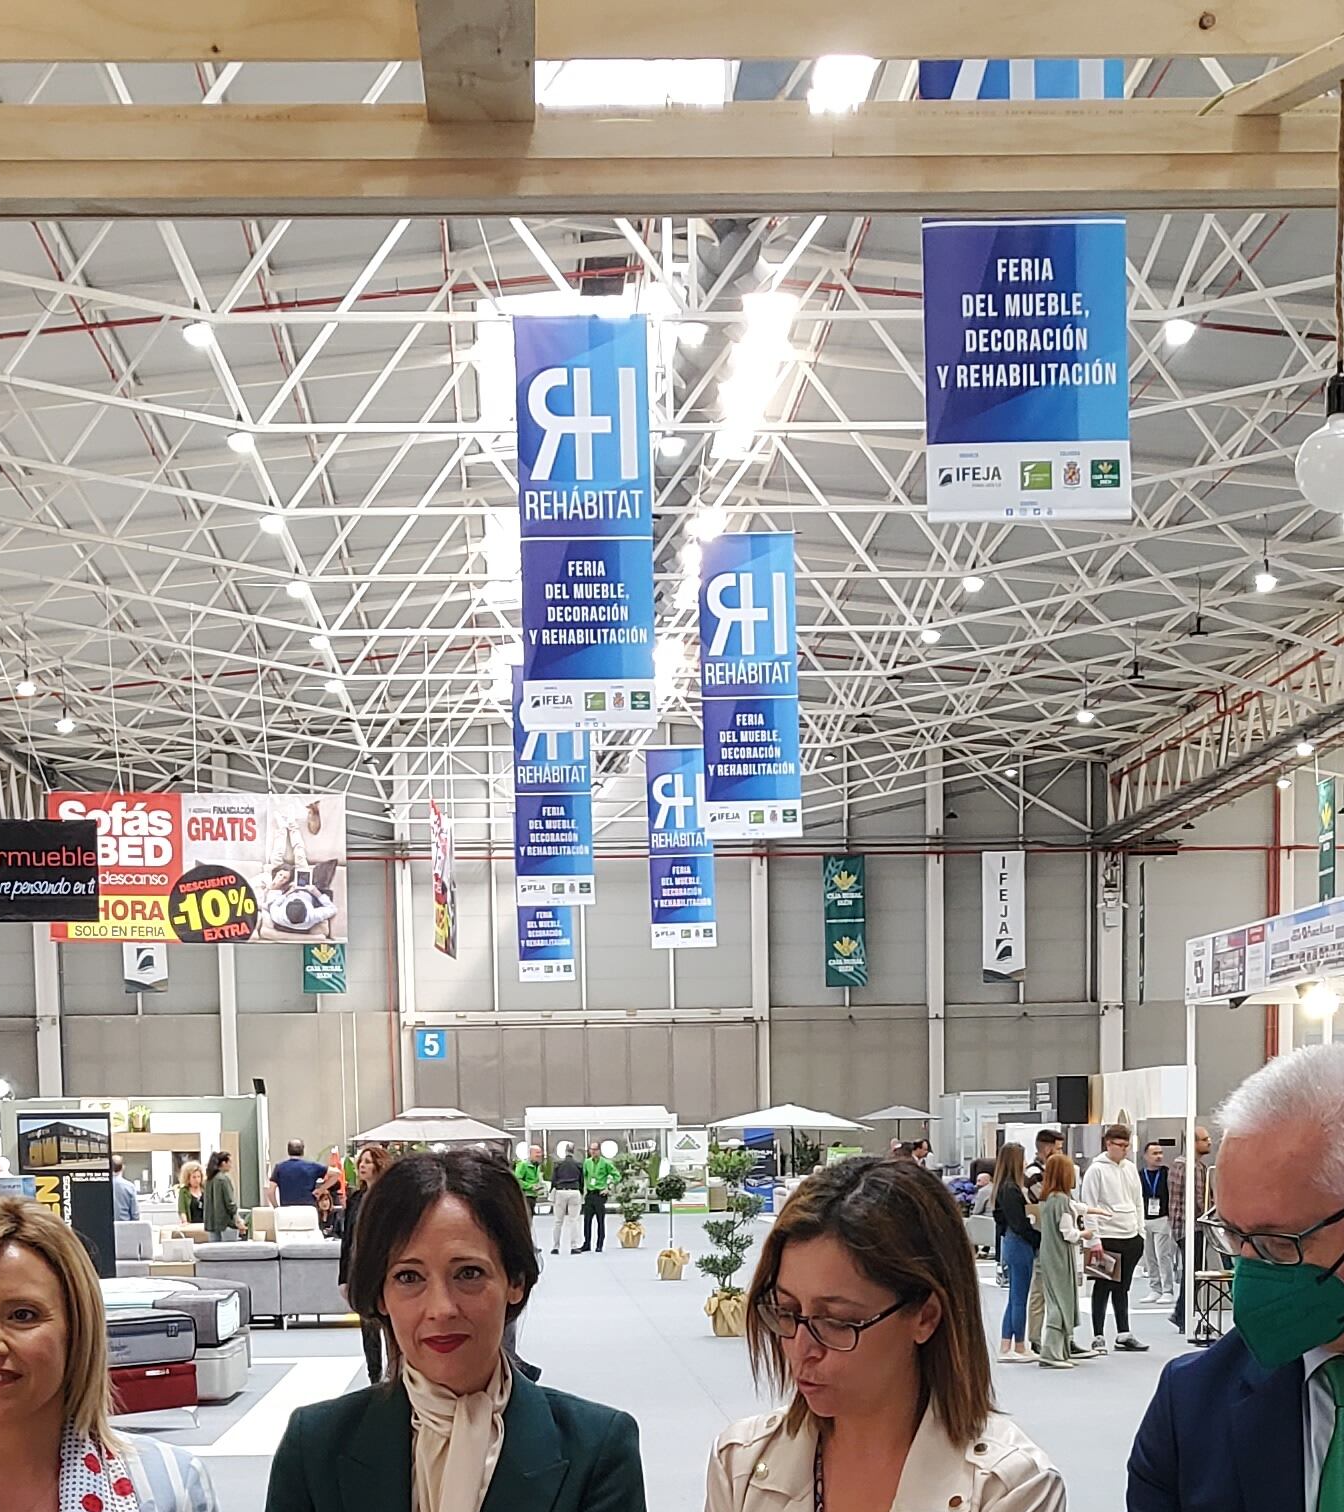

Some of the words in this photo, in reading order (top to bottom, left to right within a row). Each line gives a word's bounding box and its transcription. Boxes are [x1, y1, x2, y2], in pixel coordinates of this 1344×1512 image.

[997, 257, 1054, 282] FERIA
[962, 293, 998, 318] DEL
[1005, 293, 1090, 319] MUEBLE,
[965, 323, 1088, 353] DECORACIÓN
[936, 365, 949, 389] Y
[956, 358, 1117, 388] REHABILITACIÓN
[956, 466, 1002, 482] IFEJA
[524, 485, 643, 520] REHÁBITAT
[567, 560, 606, 577] FERIA
[545, 583, 570, 600] DEL
[547, 603, 629, 622] DECORACIÓN
[529, 629, 538, 645] Y
[542, 626, 648, 645] REHABILITACIÓN
[705, 659, 792, 685] REHÁBITAT
[542, 695, 573, 706] IFEJA
[736, 713, 765, 727] FERIA
[719, 730, 739, 743] DEL
[721, 745, 781, 760] DECORACIÓN
[517, 763, 587, 785] REHÁBITAT
[708, 764, 716, 777] Y
[717, 761, 795, 777] REHABILITACIÓN
[58, 800, 173, 837] Sofás
[212, 804, 254, 814] FINANCIACIÓN
[542, 806, 566, 817] FERIA
[187, 816, 256, 841] GRATIS
[528, 820, 544, 830] DEL
[530, 832, 578, 843] DECORACIÓN
[520, 846, 526, 857] Y
[527, 844, 589, 857] REHABILITACIÓN
[100, 871, 168, 886] descanso
[178, 875, 236, 893] DESCUENTO
[10, 877, 72, 900] pensando
[72, 881, 86, 895] en
[999, 856, 1008, 934] IFEJA
[99, 900, 165, 921] HORA
[173, 887, 255, 932] -10%
[74, 926, 108, 937] SOLO
[112, 926, 127, 937] EN
[130, 926, 166, 937] FERIA
[203, 922, 250, 942] EXTRA
[424, 1034, 440, 1056] 5
